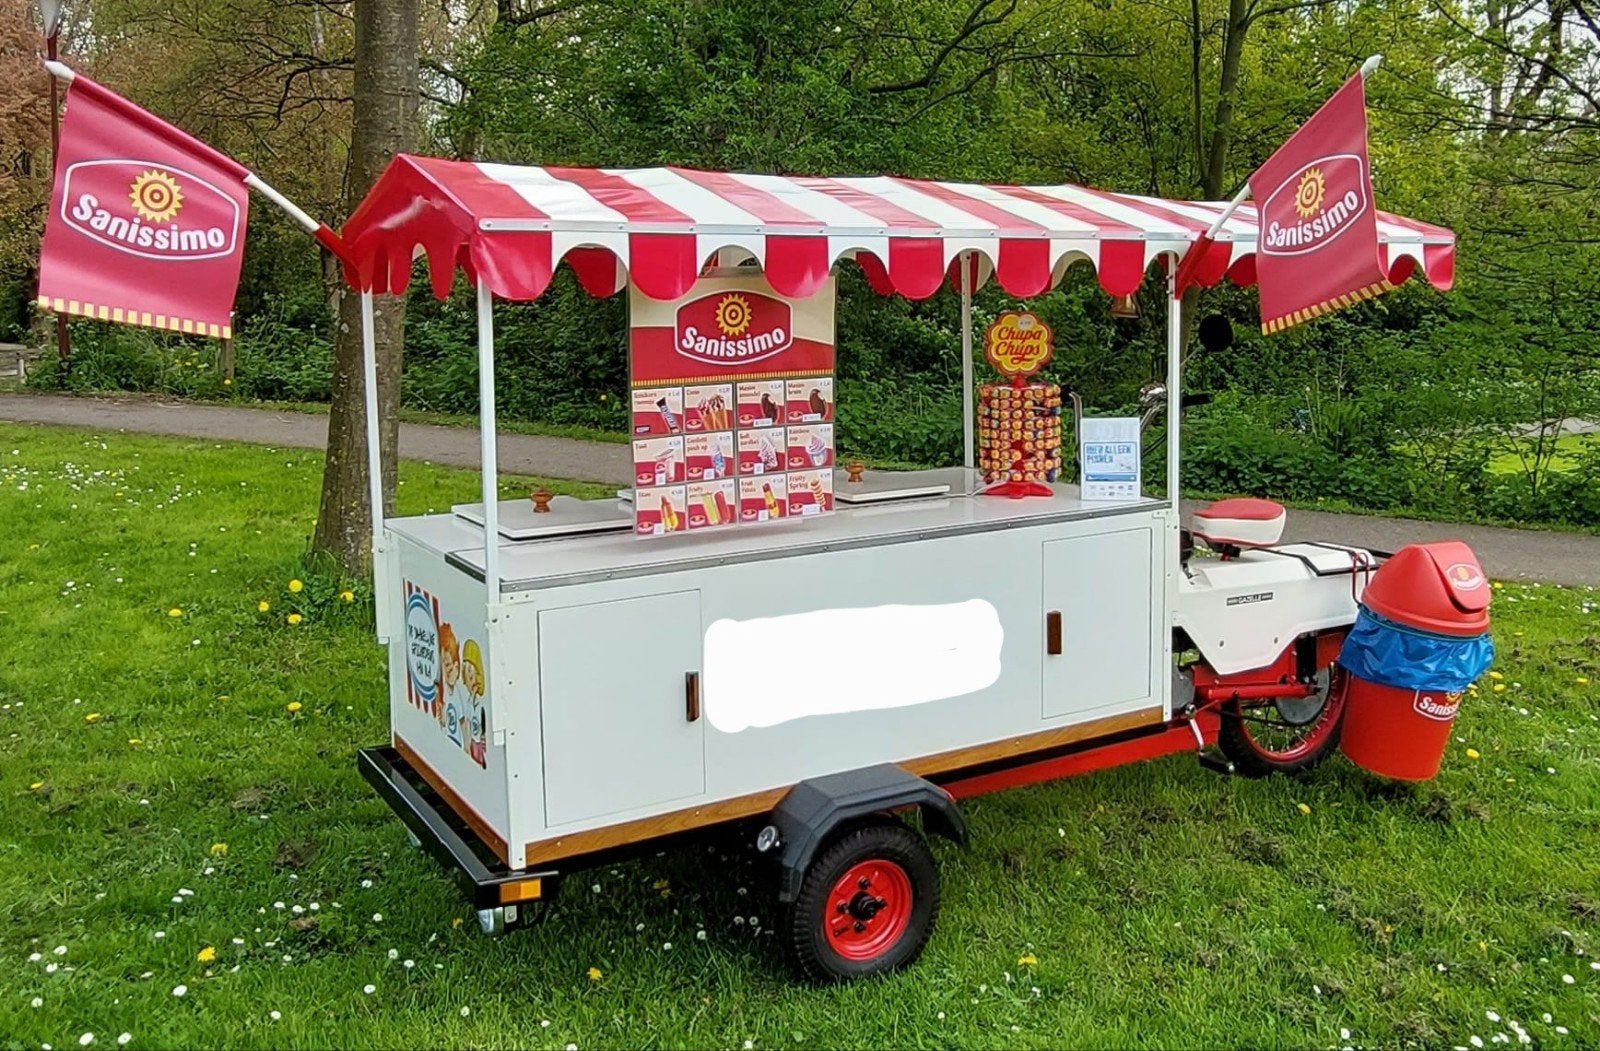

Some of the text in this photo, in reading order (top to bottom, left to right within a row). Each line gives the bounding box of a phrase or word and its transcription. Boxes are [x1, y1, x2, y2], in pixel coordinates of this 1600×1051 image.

[72, 194, 225, 250] Sanissimo
[1267, 191, 1358, 246] Sanissimo
[682, 327, 785, 357] Sanissimo
[998, 327, 1042, 343] Chupa
[996, 341, 1039, 364] Chups
